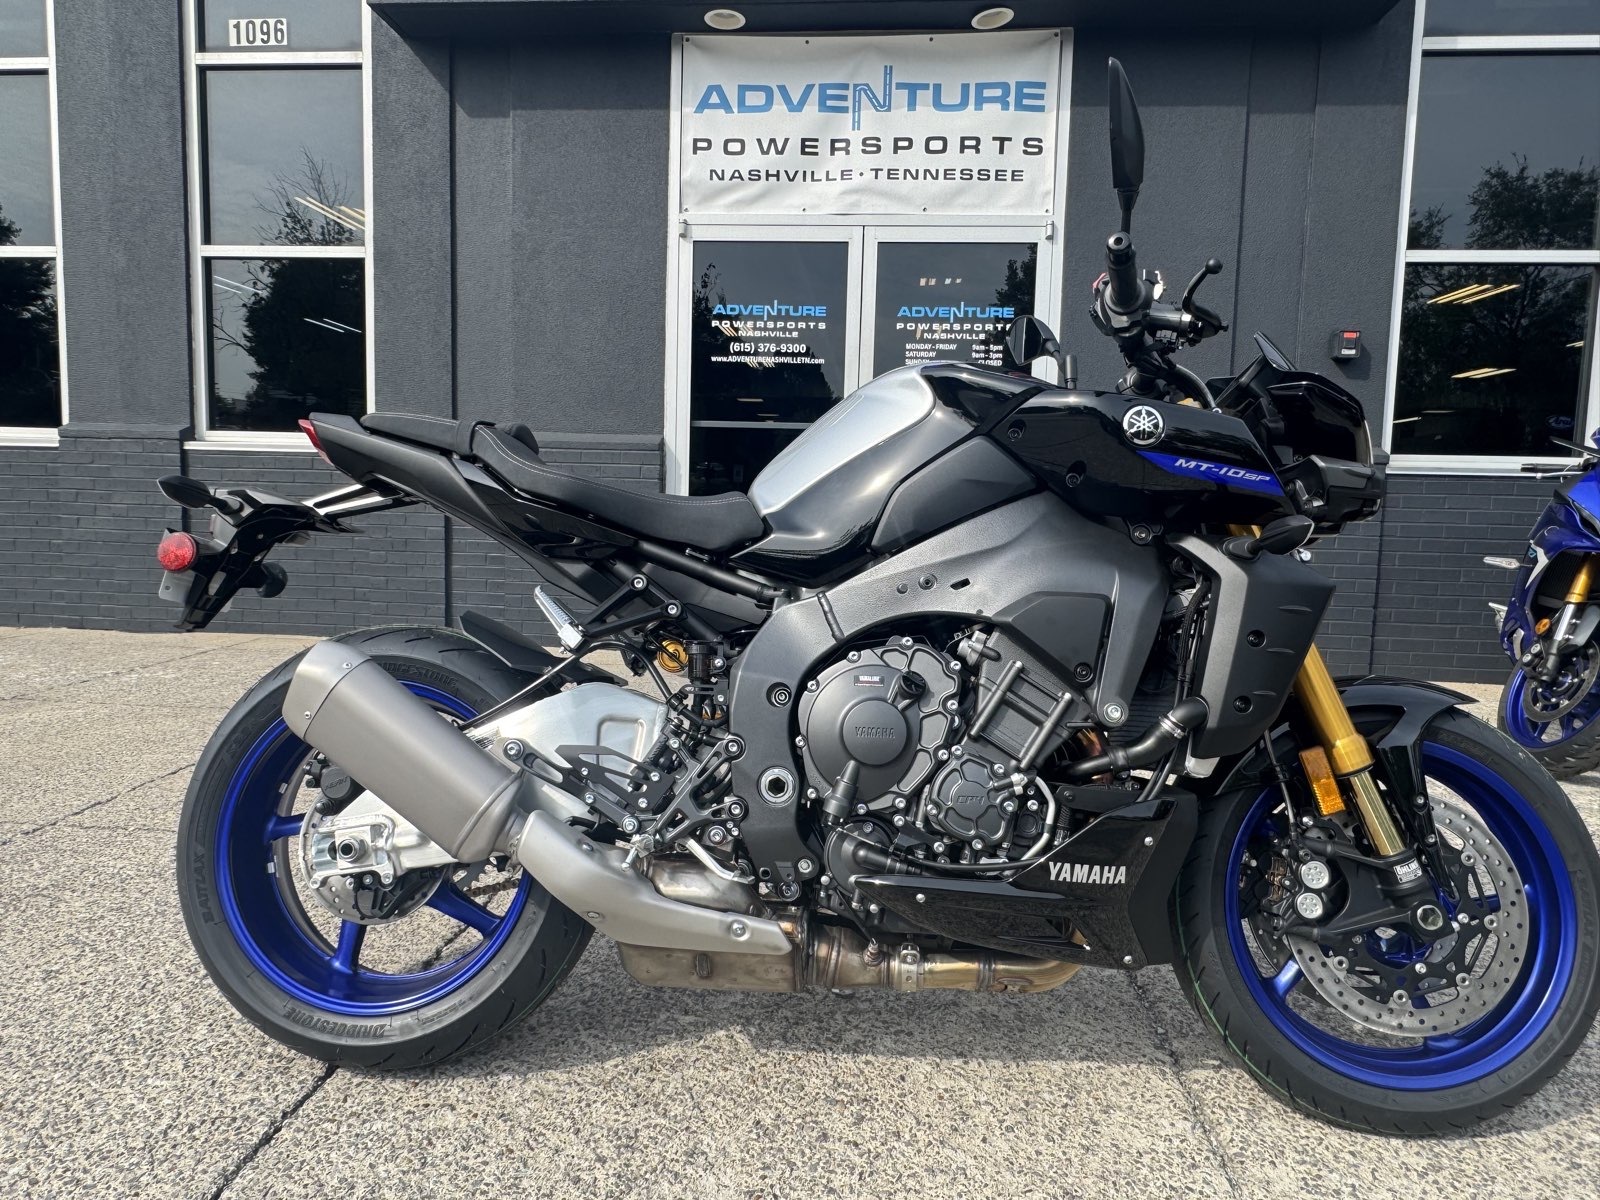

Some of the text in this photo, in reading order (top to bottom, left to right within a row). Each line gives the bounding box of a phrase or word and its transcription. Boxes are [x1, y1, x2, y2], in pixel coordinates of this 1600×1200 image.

[232, 19, 285, 45] 1096
[693, 65, 1046, 131] ADVENTURE
[692, 136, 1044, 156] POWERSPORTS
[709, 167, 1024, 183] NASHVILLE TENNESSEE
[712, 300, 827, 321] ADVENTURE
[897, 302, 1015, 323] ADVENTURE
[711, 320, 826, 329] POWERSPORTS
[738, 330, 799, 338] NASHVILLE
[923, 332, 986, 340] NASHVILLE
[729, 342, 807, 354] (615) 376-9300
[855, 726, 896, 739] YAMAHA
[1048, 861, 1127, 885] YAMAHA
[283, 1006, 387, 1038] BRIDGESTONE
